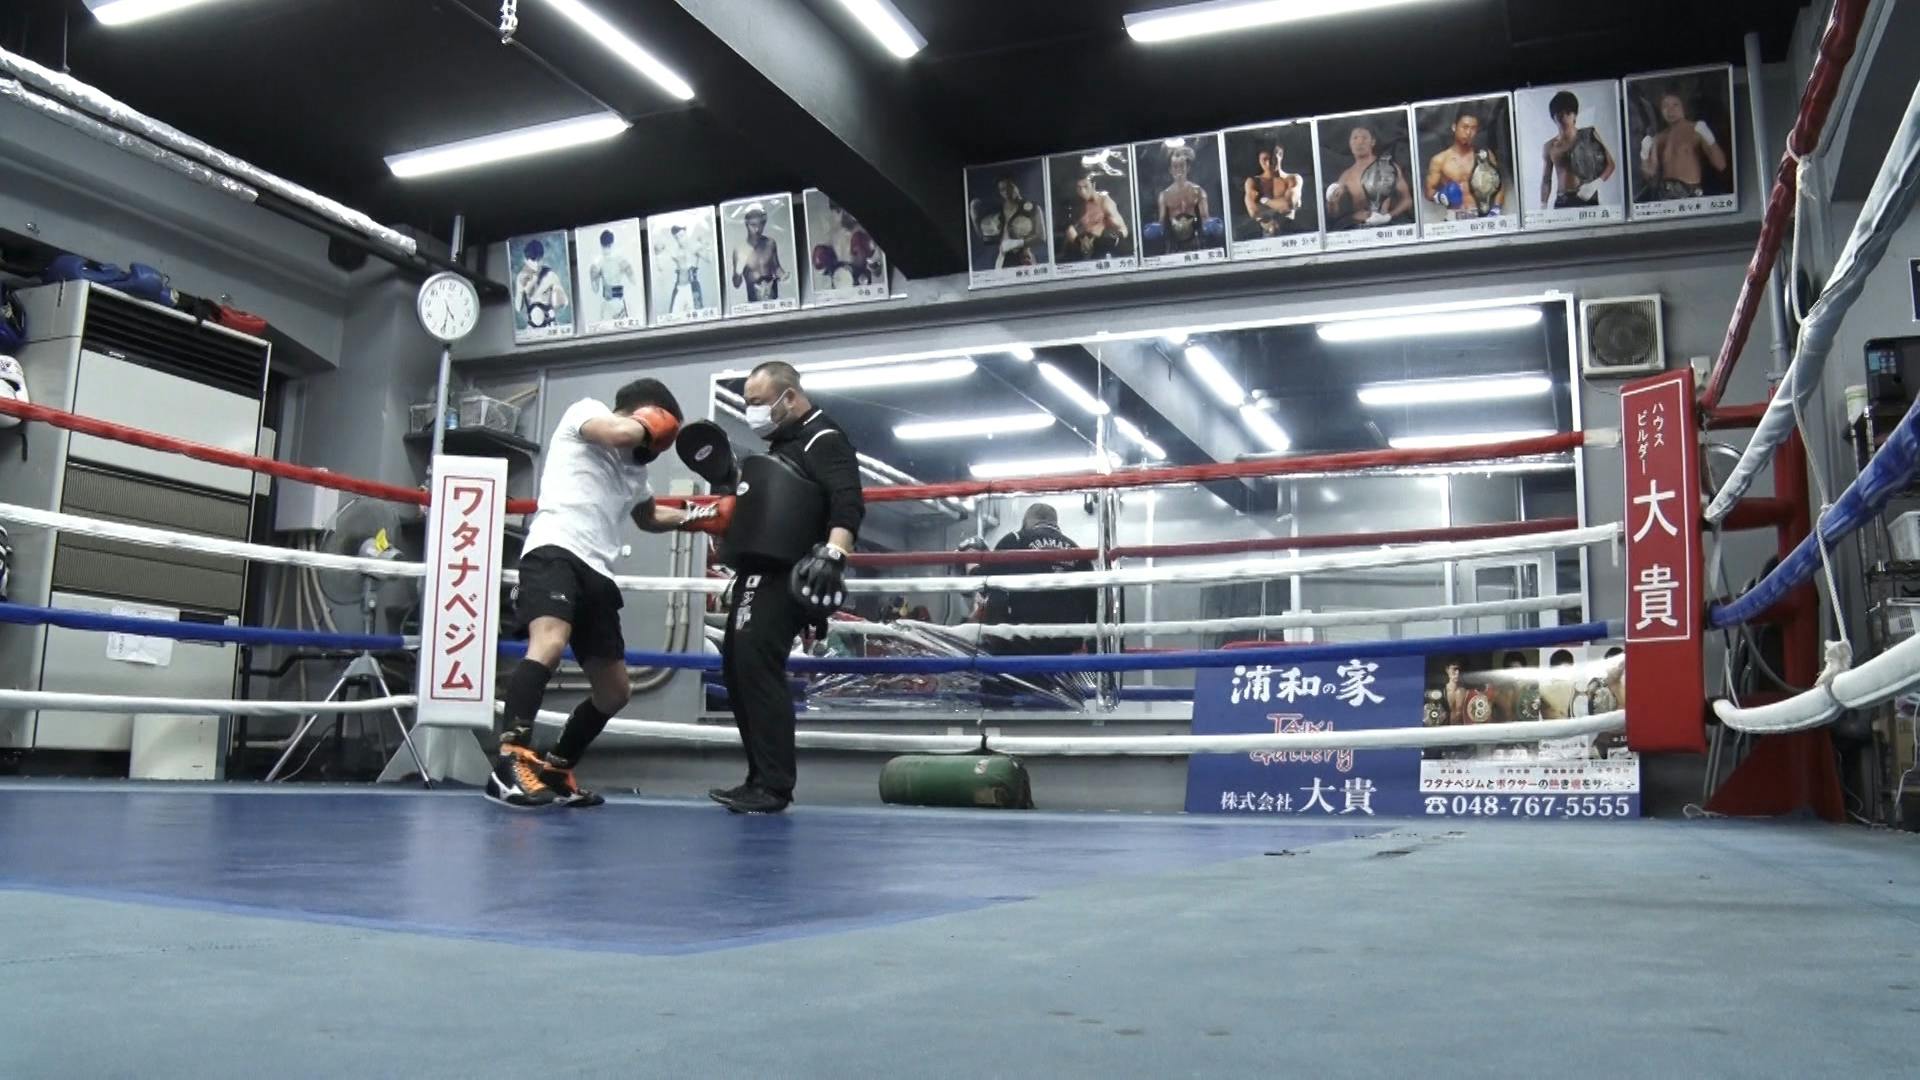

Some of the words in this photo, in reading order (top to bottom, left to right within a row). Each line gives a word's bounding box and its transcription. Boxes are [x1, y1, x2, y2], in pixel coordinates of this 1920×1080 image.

[1637, 409, 1649, 476] ビルダー
[1652, 402, 1665, 448] ハウス
[1633, 479, 1680, 631] 大貴
[441, 486, 484, 691] ワタナベジム
[1231, 659, 1386, 707] 浦和の家
[1220, 791, 1293, 812] 株式会社
[1298, 777, 1378, 815] 大貴
[1452, 796, 1630, 816] 048-767-5555
